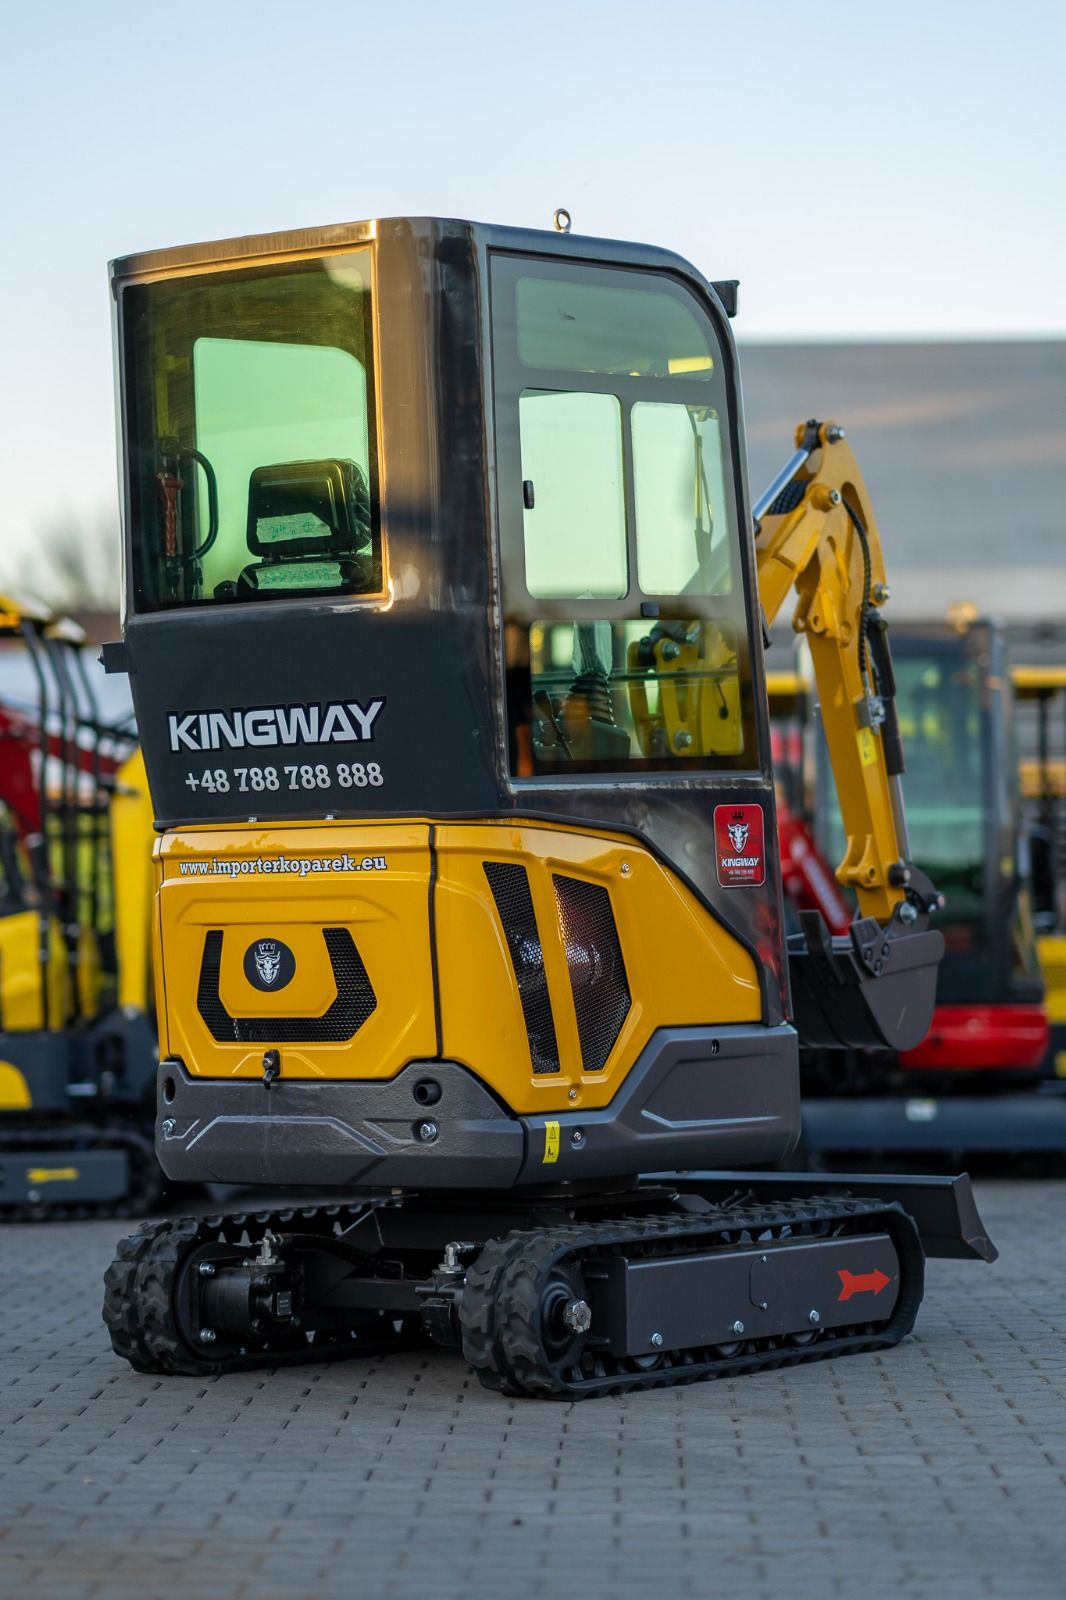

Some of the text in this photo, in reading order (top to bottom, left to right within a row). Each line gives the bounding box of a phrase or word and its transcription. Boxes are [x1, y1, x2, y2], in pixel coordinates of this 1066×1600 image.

[168, 700, 384, 751] KINGWAY
[185, 762, 384, 793] +48 788 788 888
[179, 854, 388, 878] www.importerkoparek.eu
[721, 857, 760, 867] KINGWAY
